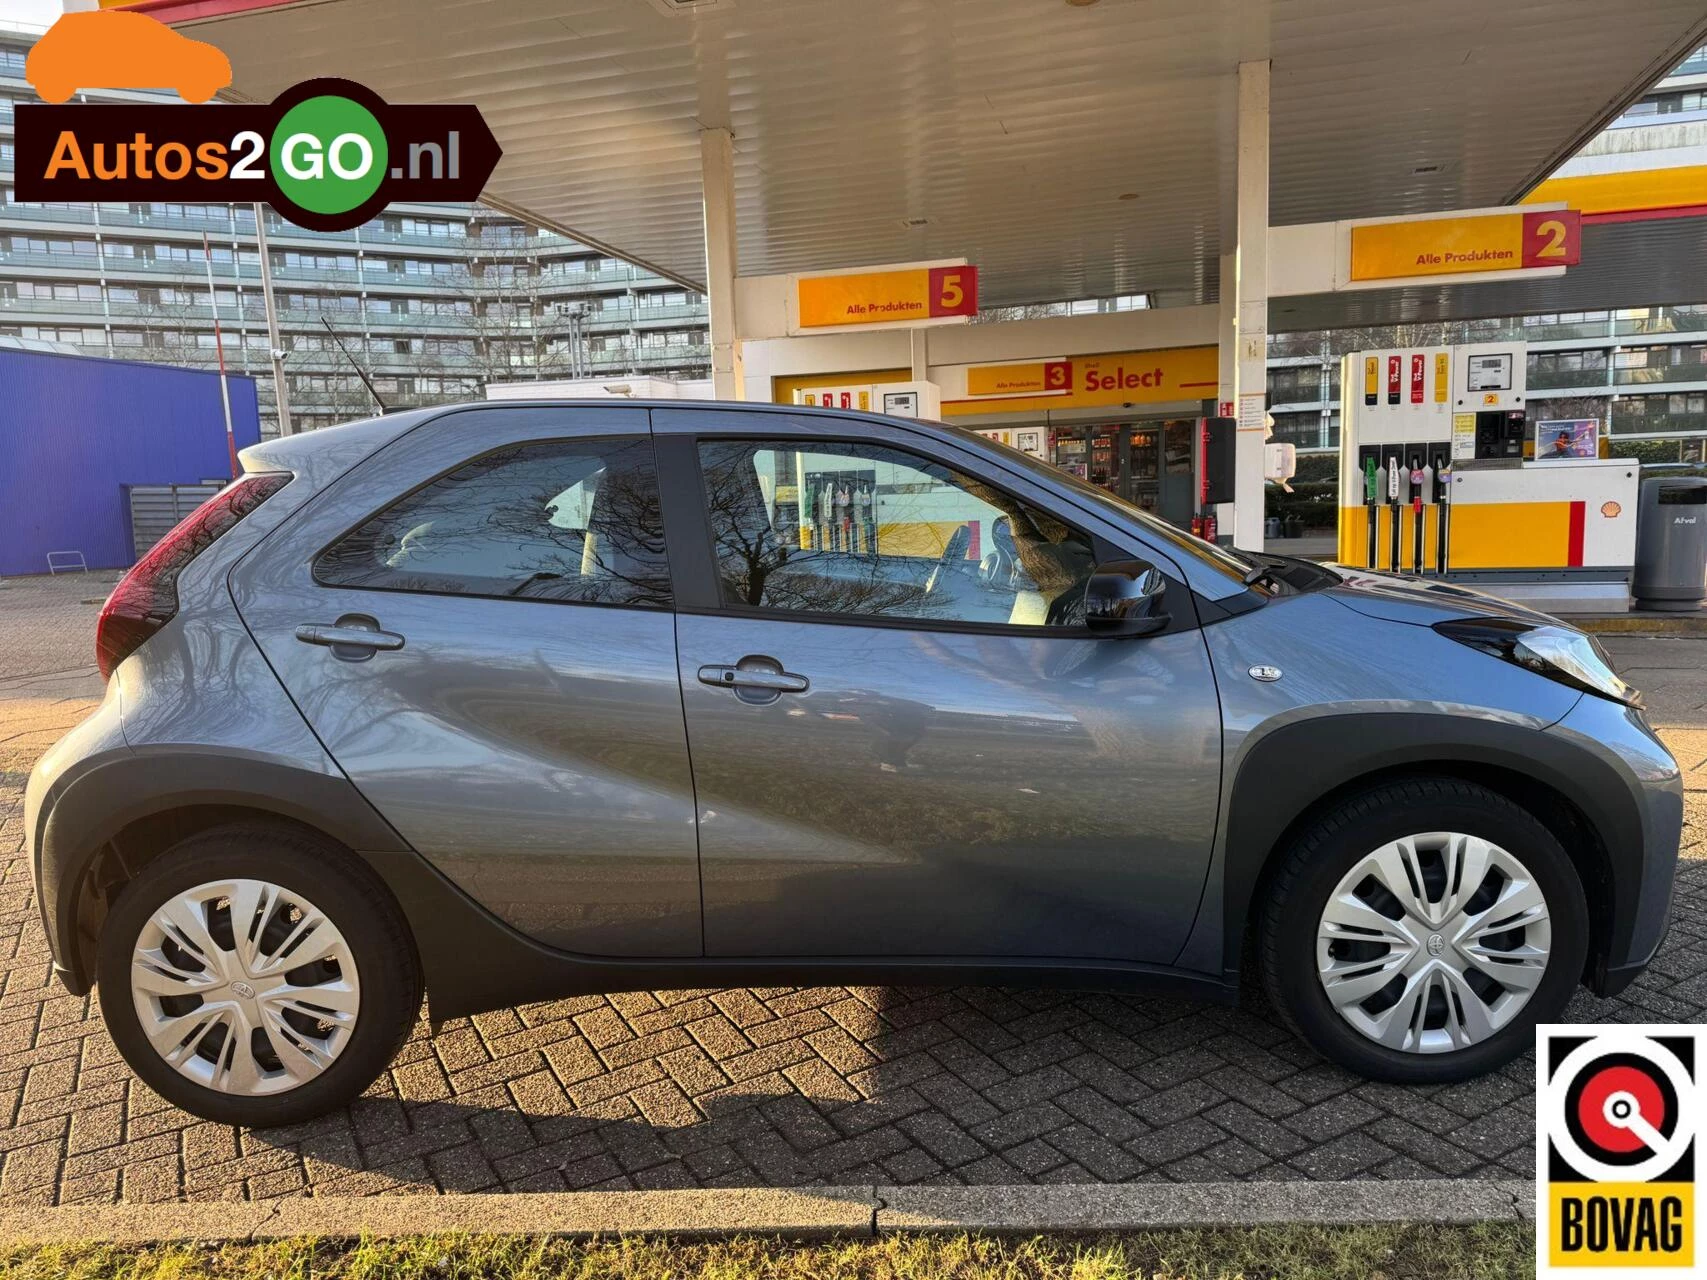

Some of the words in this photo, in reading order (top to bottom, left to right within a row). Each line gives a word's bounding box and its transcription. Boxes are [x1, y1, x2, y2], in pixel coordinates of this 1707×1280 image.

[1535, 220, 1567, 258] 2
[1415, 253, 1442, 266] Alle
[1444, 249, 1513, 263] Produkten
[940, 274, 964, 309] 5
[846, 304, 866, 315] Alle
[868, 300, 923, 313] Produkten
[1050, 366, 1066, 386] 3
[1085, 367, 1164, 392] Select
[1487, 395, 1495, 403] 2
